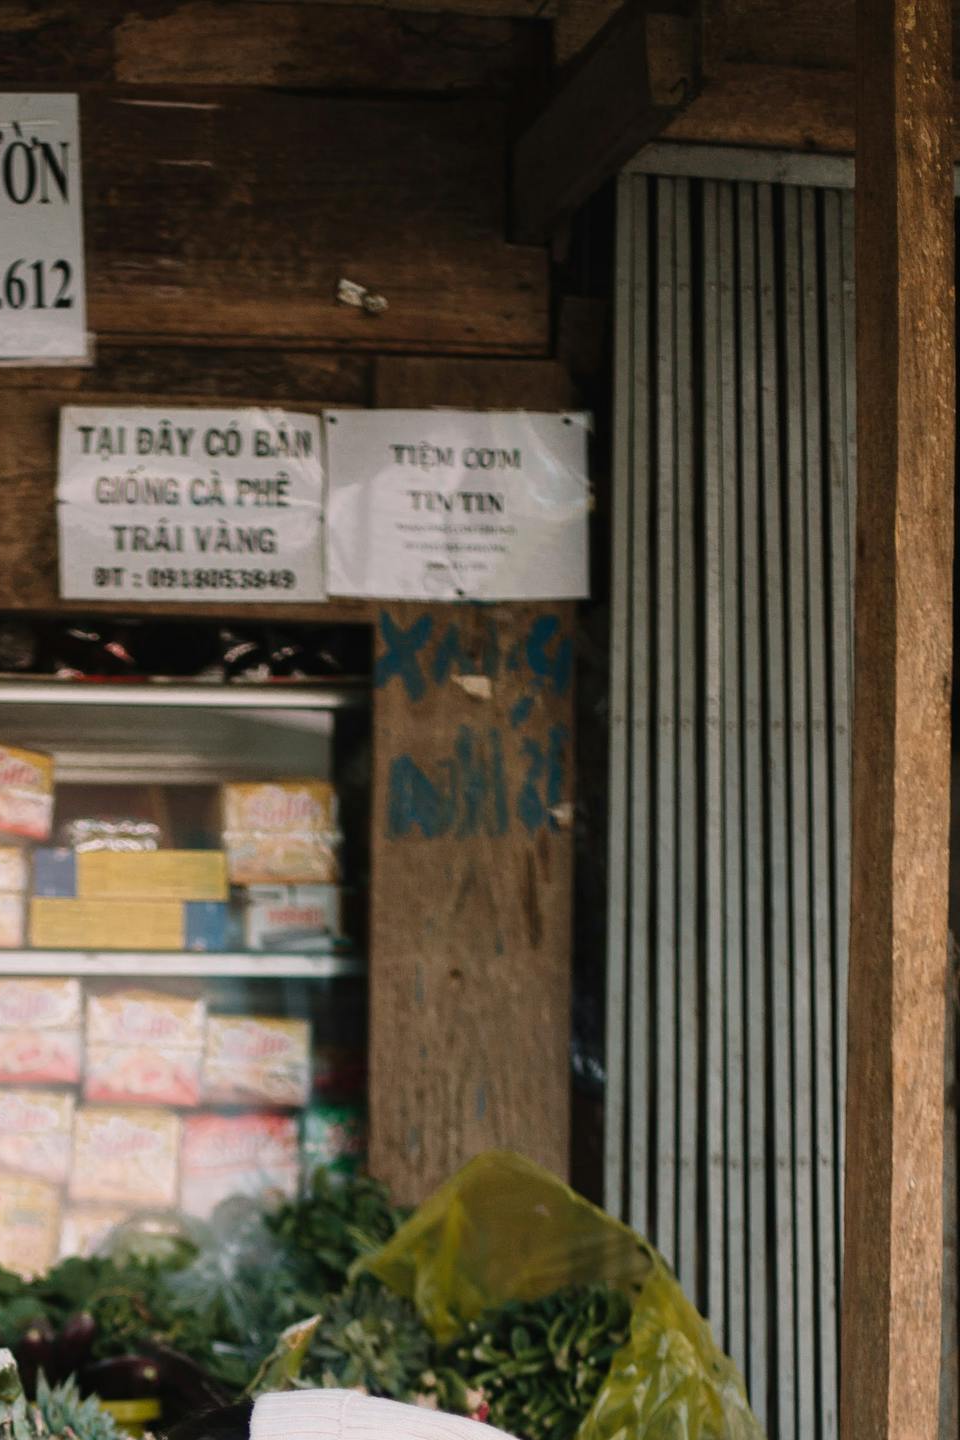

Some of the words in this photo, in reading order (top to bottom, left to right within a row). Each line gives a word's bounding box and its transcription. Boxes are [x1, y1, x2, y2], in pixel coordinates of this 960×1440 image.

[78, 426, 127, 461] TẠI
[136, 419, 196, 457] ĐÂY
[203, 421, 243, 458] CÓ
[253, 422, 313, 458] BÁN
[236, 471, 293, 507] PHÊ
[458, 491, 505, 513] TIN
